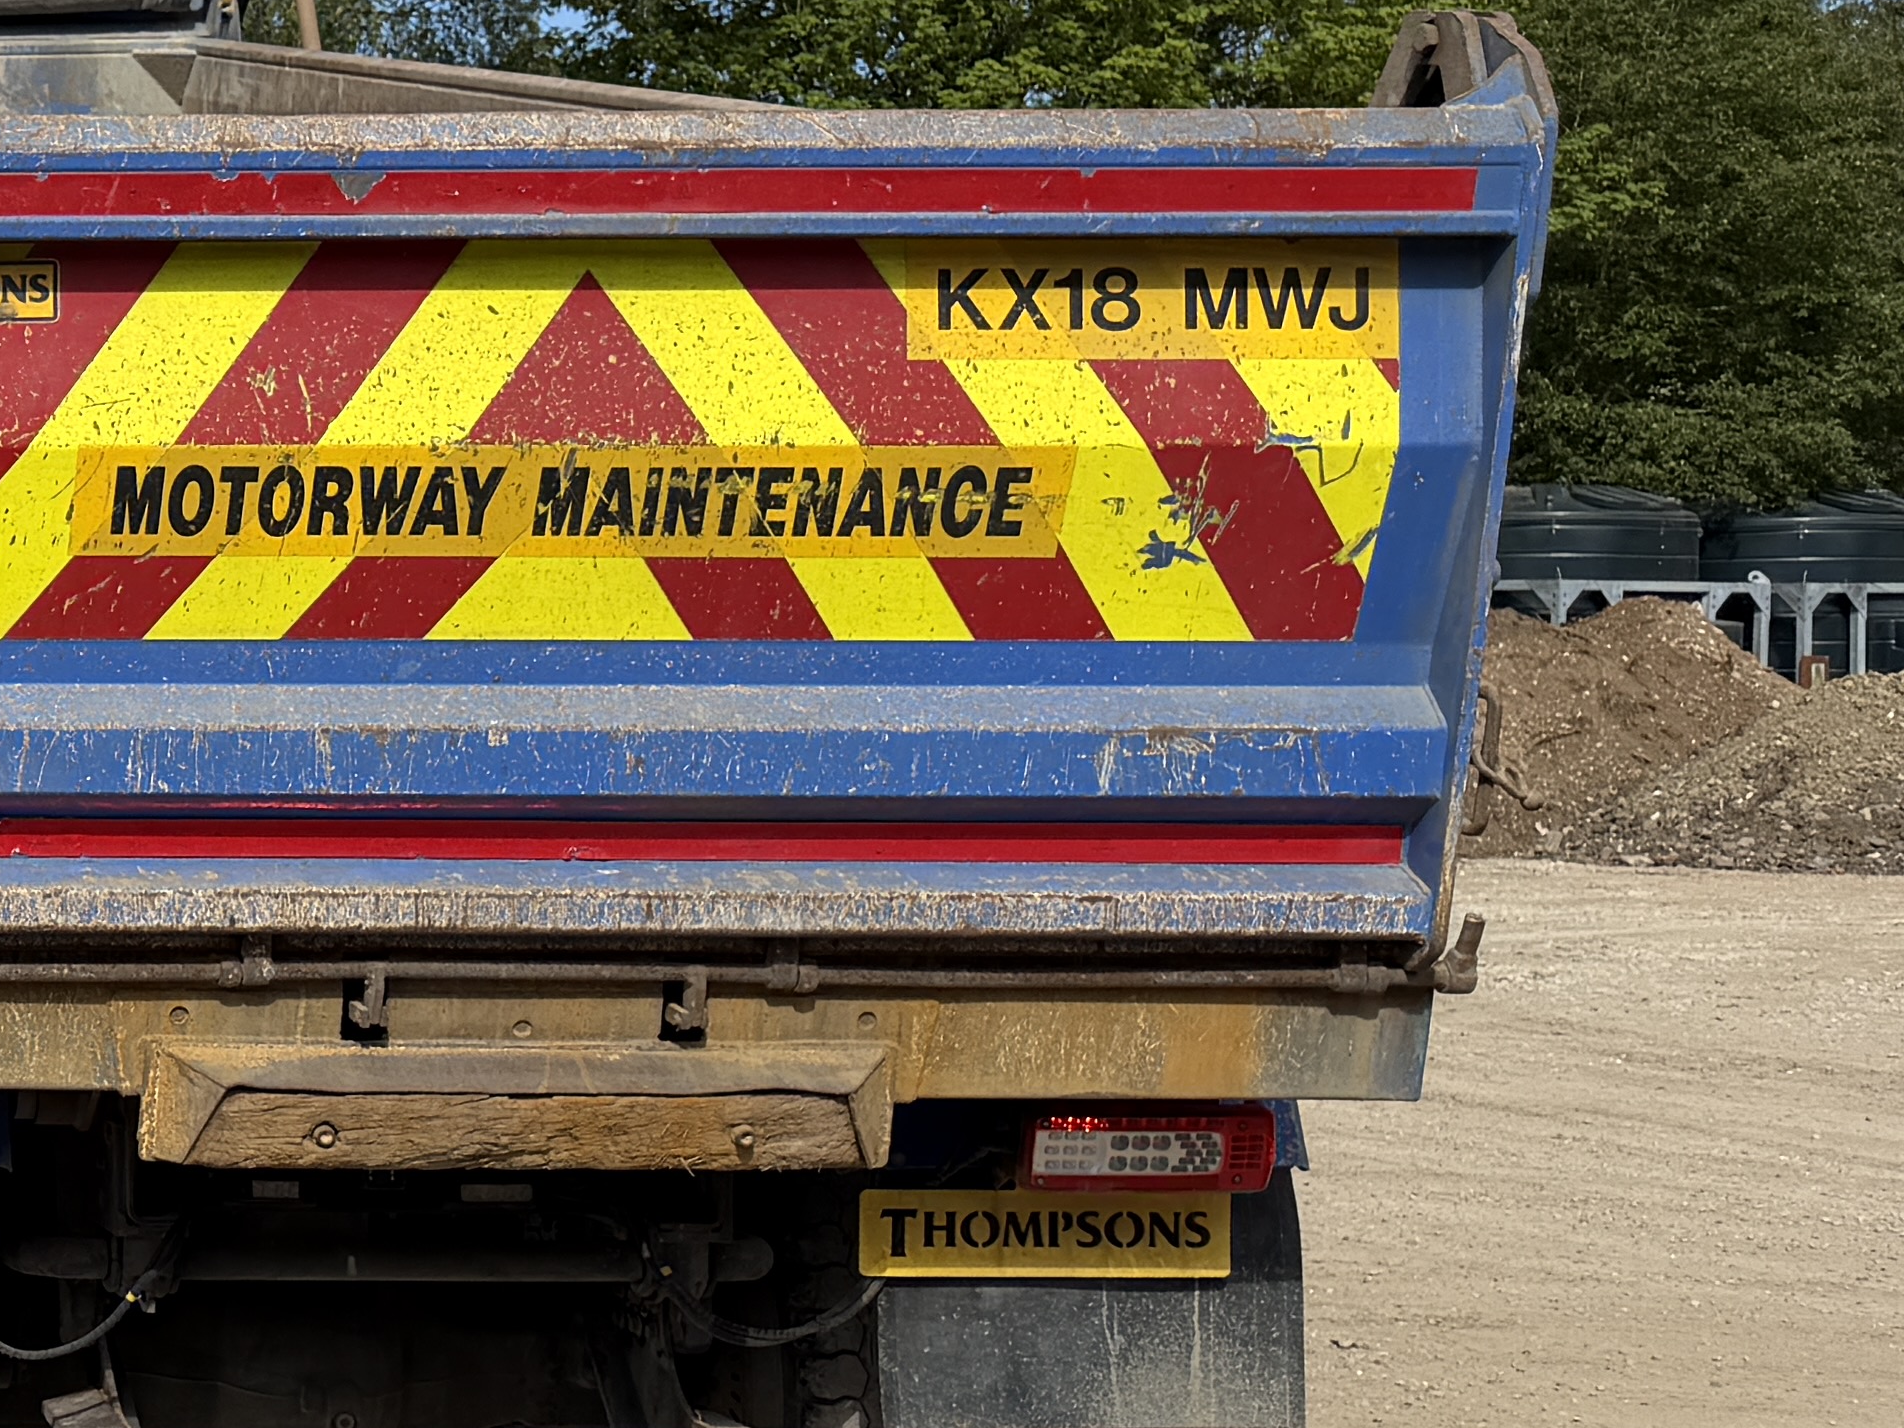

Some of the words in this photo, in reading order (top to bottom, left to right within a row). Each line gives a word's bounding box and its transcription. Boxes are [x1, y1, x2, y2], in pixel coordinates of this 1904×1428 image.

[936, 267, 1142, 332] KX18
[1184, 267, 1372, 332] MWJ
[110, 464, 508, 537] MOTORWAY
[531, 465, 1033, 538] MAINTENANCE
[880, 1208, 1211, 1257] THOMPSONS
